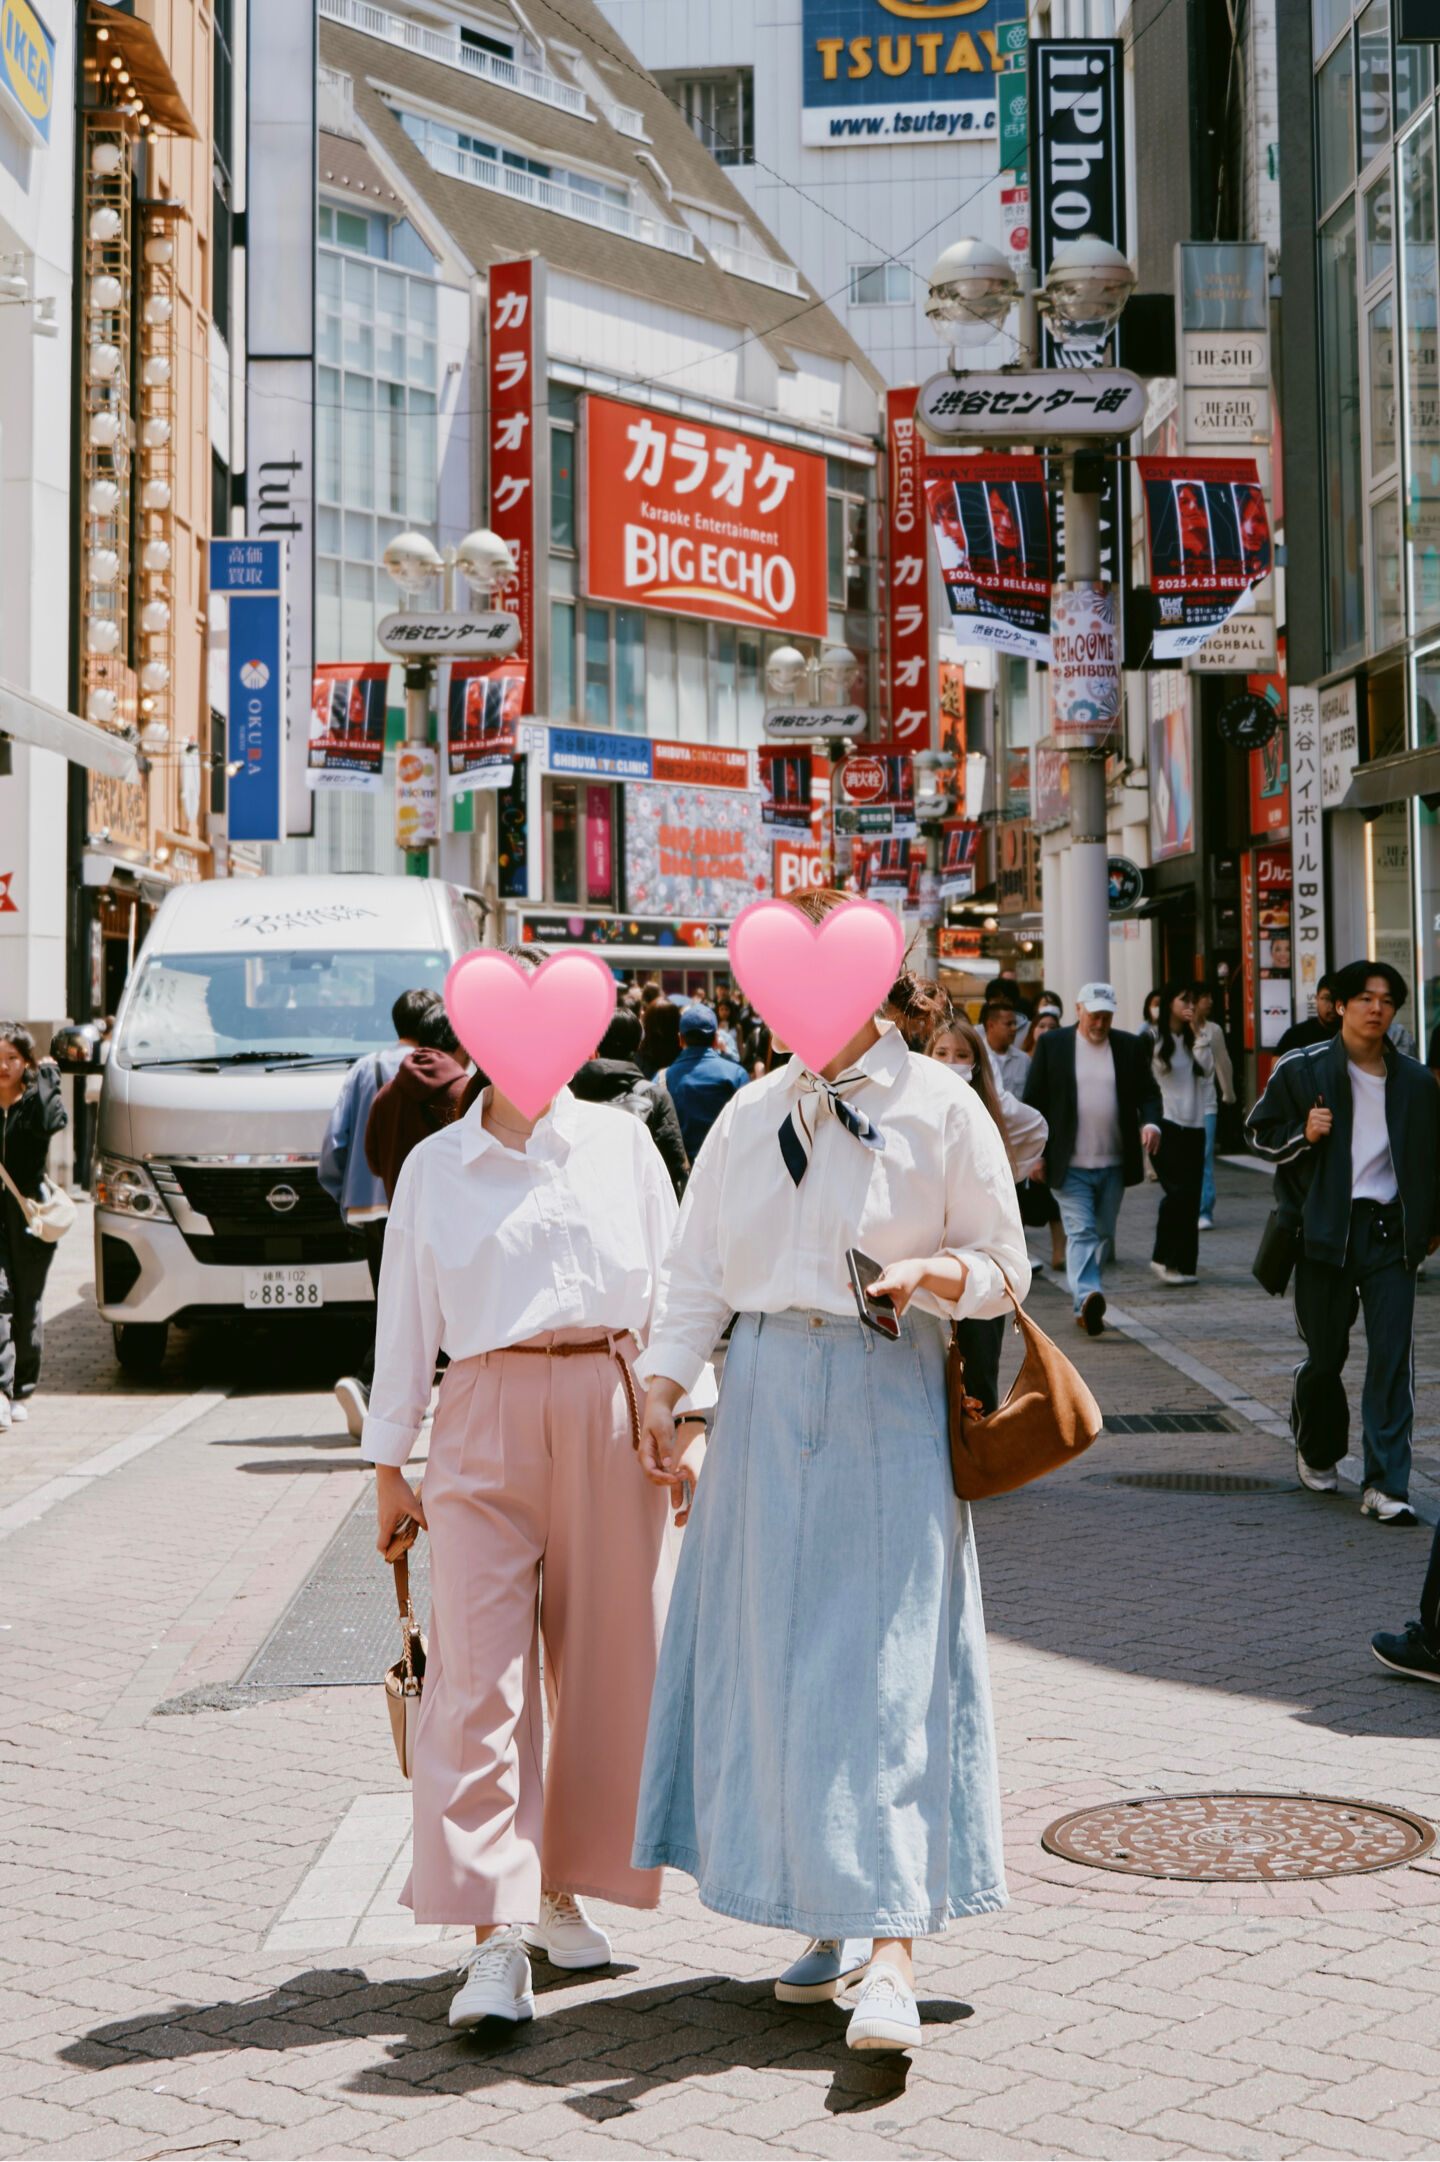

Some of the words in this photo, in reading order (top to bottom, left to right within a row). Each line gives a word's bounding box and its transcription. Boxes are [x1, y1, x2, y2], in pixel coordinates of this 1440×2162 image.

[6, 8, 48, 107] IKEA
[829, 110, 996, 137] www.tsutaya.c
[494, 291, 530, 511] カラオケ
[929, 388, 1132, 415] 渋谷センター街
[893, 418, 914, 462] BIG
[624, 418, 795, 513] カラオケ
[927, 467, 970, 478] GLAY
[895, 466, 915, 532] ECHO
[641, 501, 690, 528] Karaoke
[694, 511, 779, 547] Entertainment
[228, 546, 263, 564] 高価
[624, 523, 695, 587] BIG
[701, 543, 797, 614] ECHO
[228, 568, 263, 585] 買取
[1003, 578, 1047, 593] RELEASE
[1158, 577, 1217, 590] 2025.4.23
[386, 624, 511, 641] 渋谷センター街
[1200, 639, 1265, 650] HIGHBALL
[893, 556, 927, 738] カラオケ
[1053, 632, 1114, 662] WELCOME
[1200, 654, 1226, 664] BAR
[1064, 664, 1118, 678] SHIBUYA
[769, 714, 860, 727] 渋谷センター街
[248, 699, 262, 775] OKURA
[553, 752, 597, 770] SHIBUYA
[617, 758, 649, 775] CLINIC
[656, 745, 690, 760] SHIBUYA
[726, 752, 747, 767] LENS
[846, 770, 880, 788] 消火栓
[1293, 704, 1319, 873] 渋谷ハイボール
[1323, 765, 1340, 796] BAR
[658, 823, 692, 854] BIG
[660, 849, 693, 877] BIG
[780, 852, 823, 895] BIG
[1299, 883, 1319, 942] BAR
[288, 1271, 306, 1281] 102
[262, 1284, 318, 1304] 88-88
